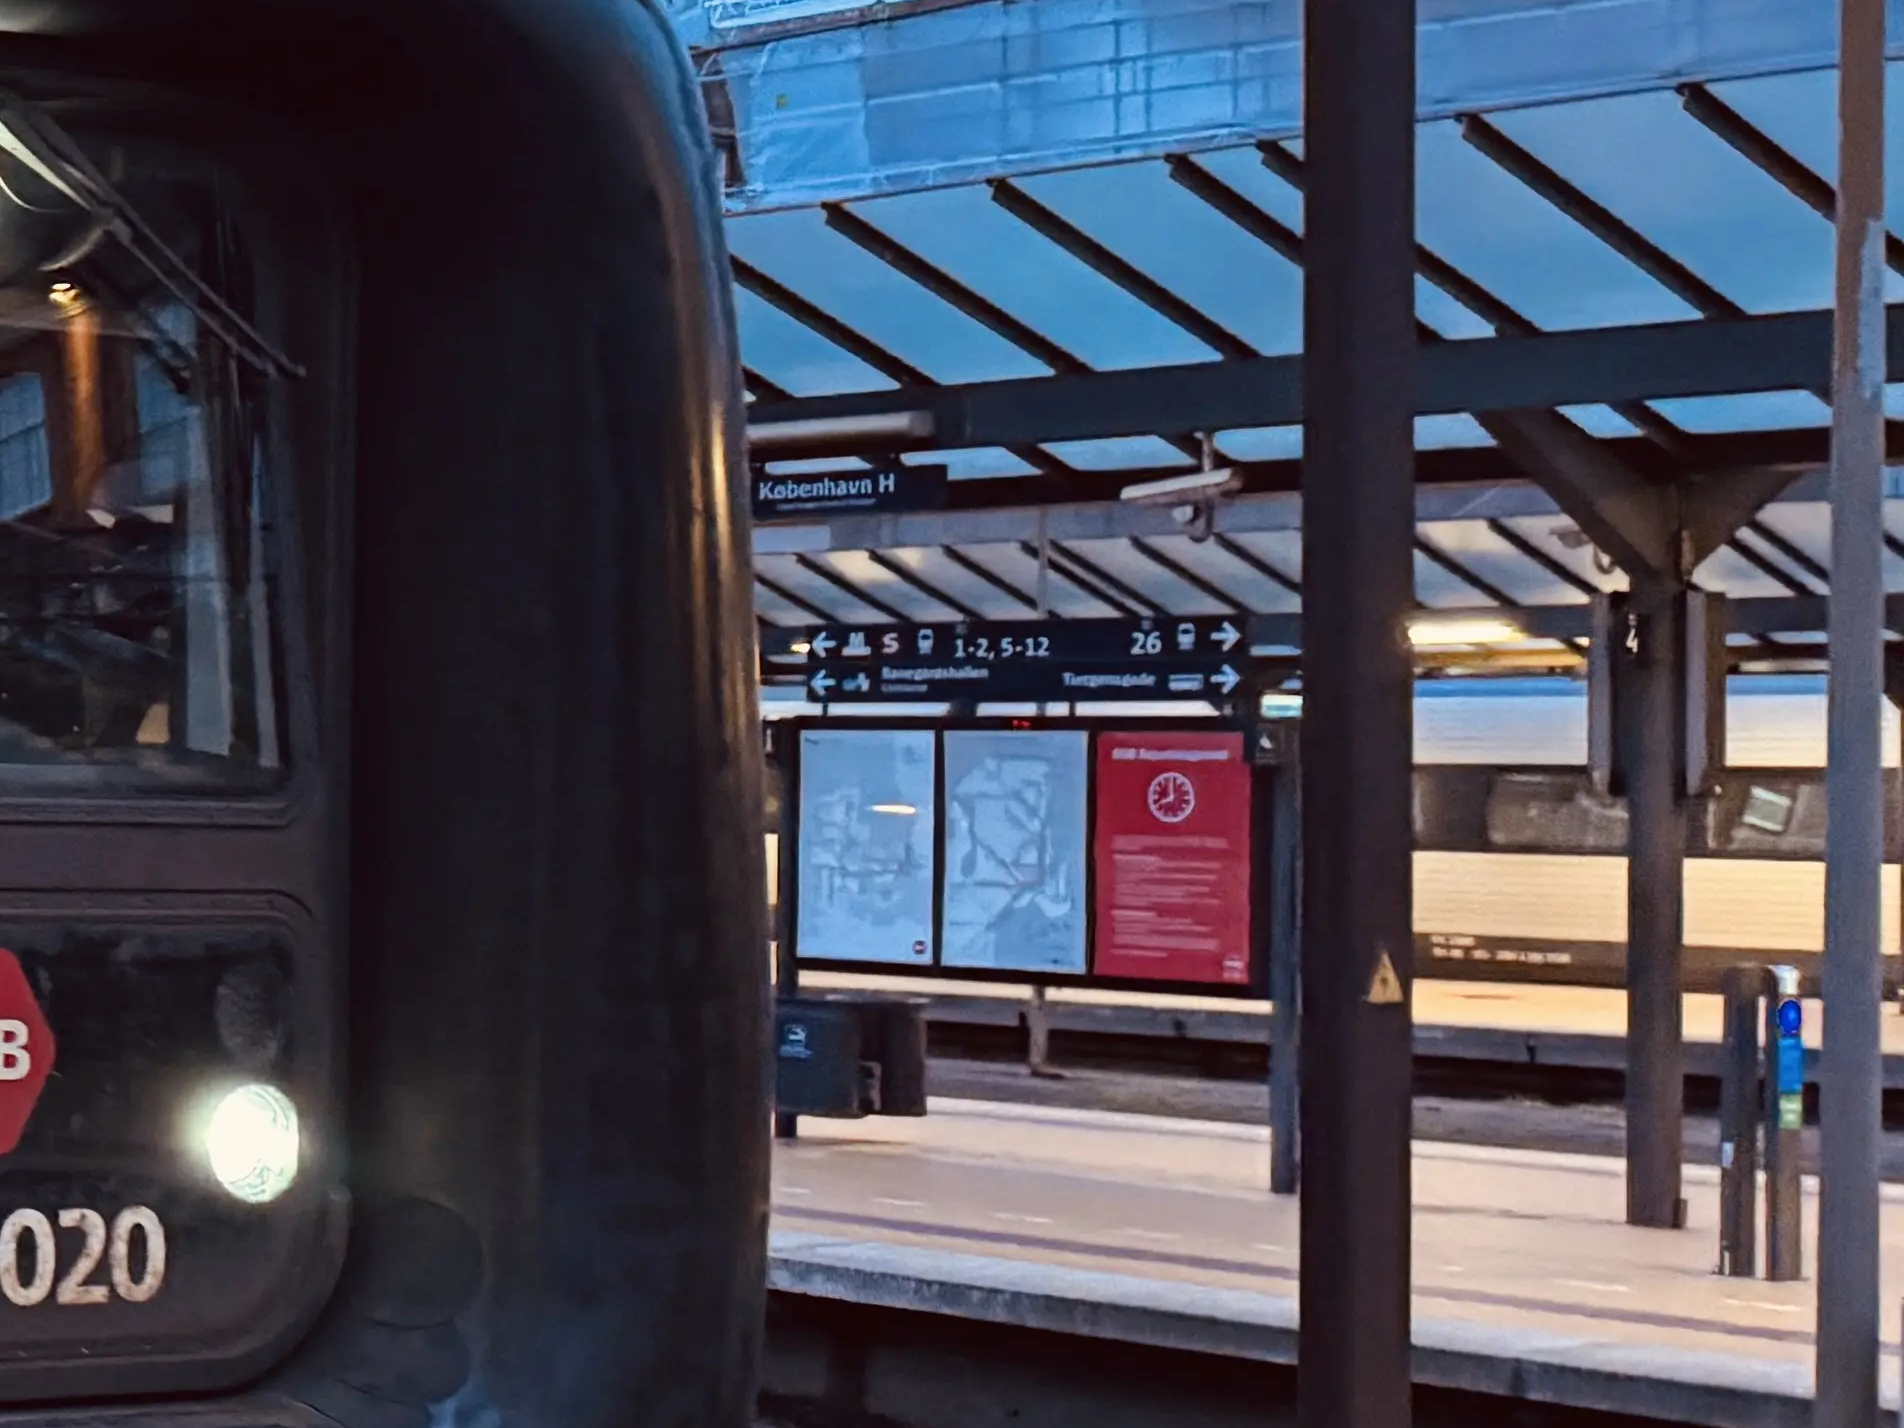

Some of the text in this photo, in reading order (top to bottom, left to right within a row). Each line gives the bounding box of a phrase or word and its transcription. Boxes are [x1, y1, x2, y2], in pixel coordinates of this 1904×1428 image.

[759, 473, 895, 500] København H
[1130, 631, 1162, 655] 26
